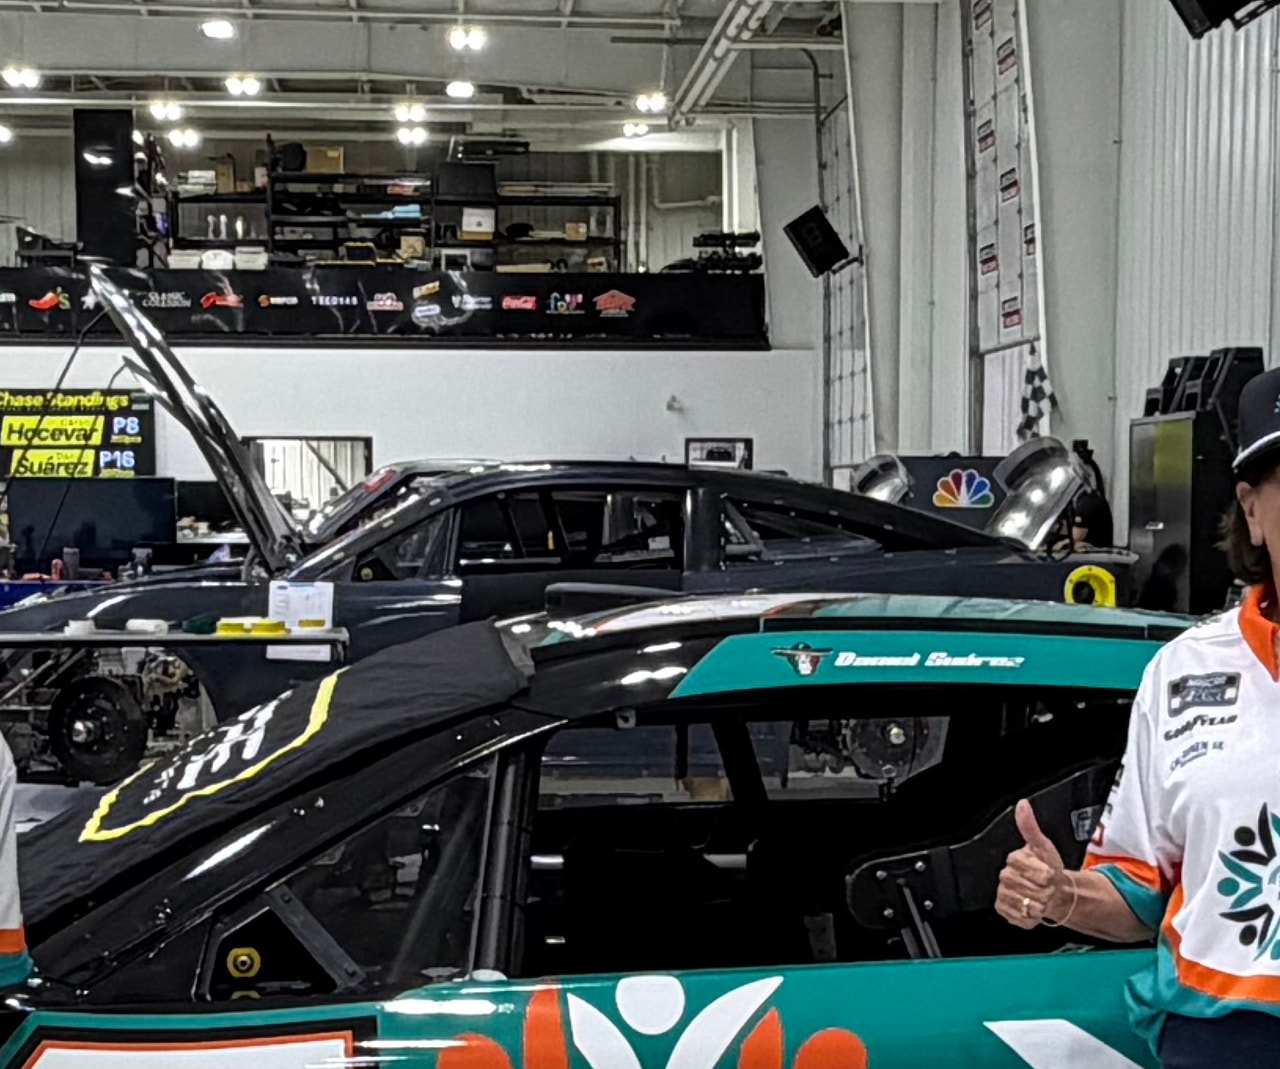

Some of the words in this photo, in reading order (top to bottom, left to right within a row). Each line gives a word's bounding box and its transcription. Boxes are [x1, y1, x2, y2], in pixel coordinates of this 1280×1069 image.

[6, 421, 98, 442] Hocevar
[112, 416, 141, 434] P8
[15, 455, 90, 475] Suárez
